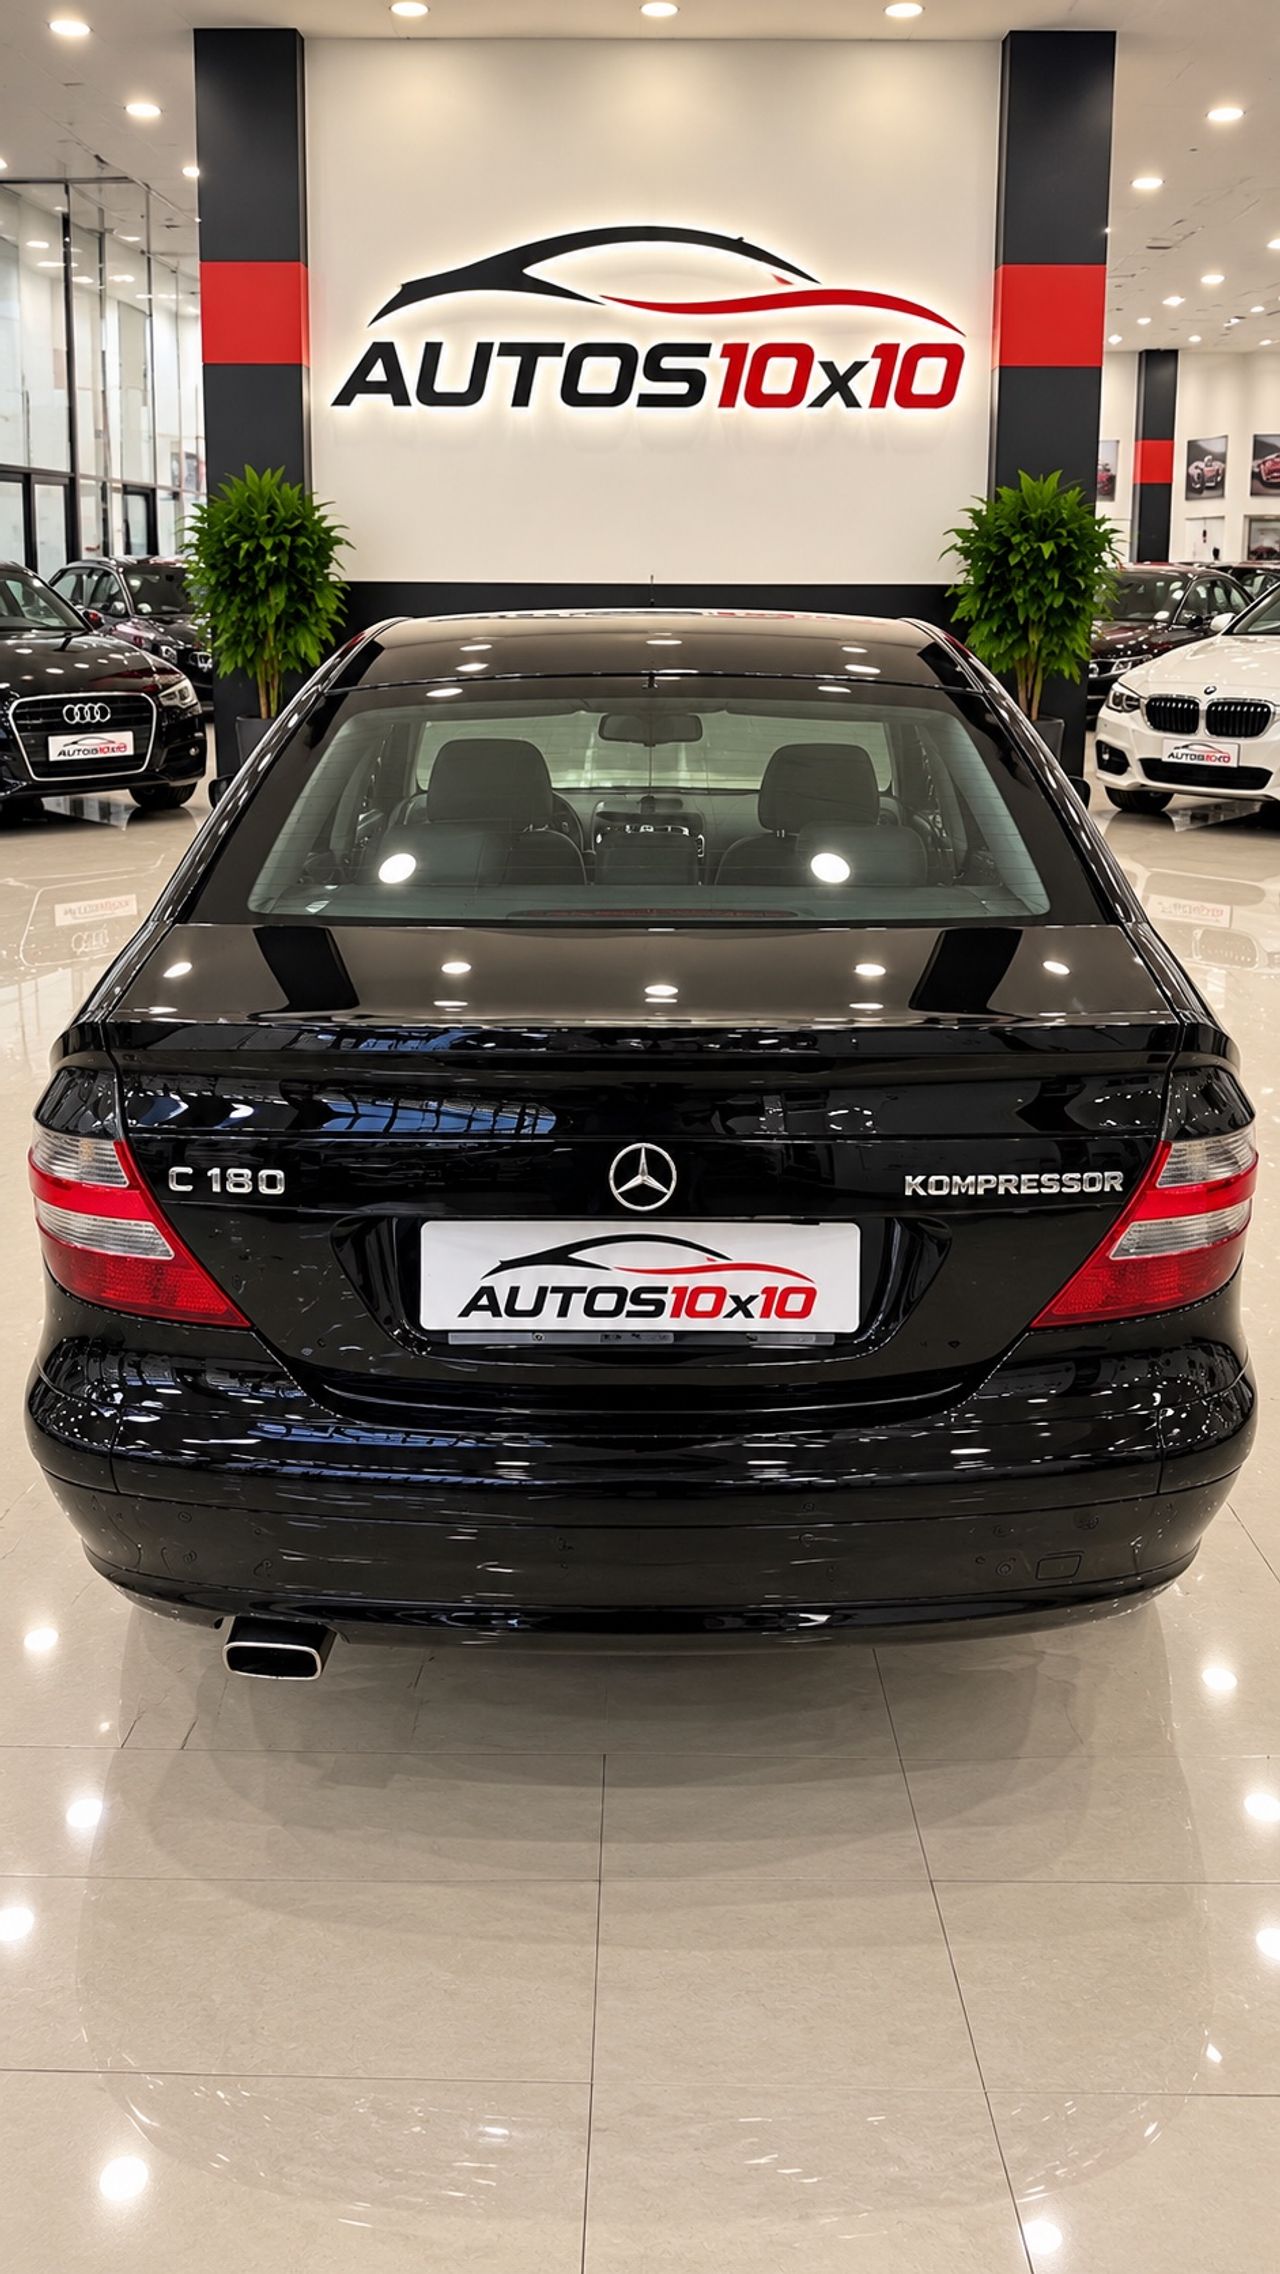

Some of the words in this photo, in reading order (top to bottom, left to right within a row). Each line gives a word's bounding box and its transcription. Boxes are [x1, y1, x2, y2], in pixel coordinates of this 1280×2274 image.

[331, 341, 965, 409] AUTOS10x10
[168, 1166, 194, 1192] C
[206, 1167, 285, 1195] 180
[904, 1170, 1124, 1197] KOMPRESSOR
[457, 1285, 817, 1319] AUTOS10x10
